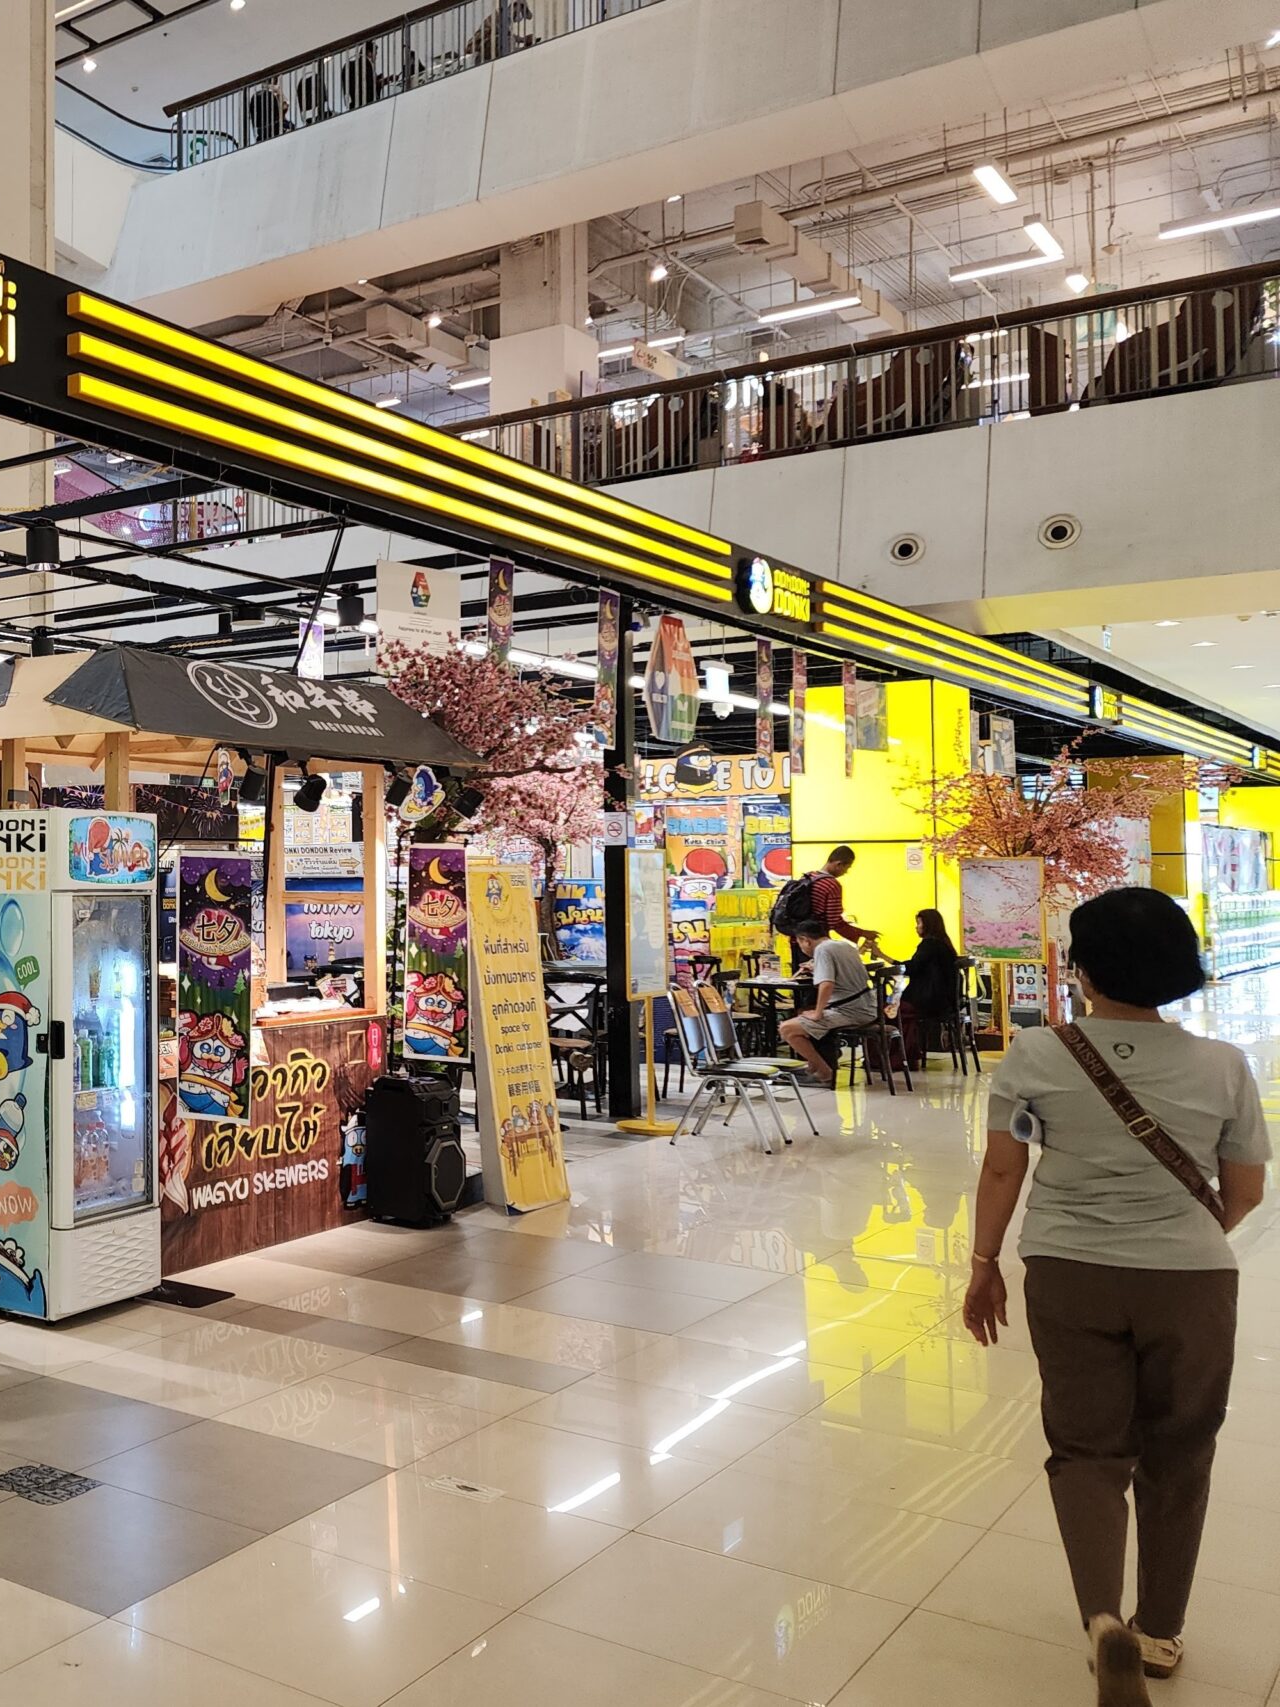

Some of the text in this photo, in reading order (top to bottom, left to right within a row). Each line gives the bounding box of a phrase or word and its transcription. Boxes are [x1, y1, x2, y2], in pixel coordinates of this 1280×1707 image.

[774, 588, 810, 622] DONKI
[423, 895, 455, 917] 七夕
[196, 914, 238, 944] 七夕
[309, 920, 355, 944] tokyo
[17, 961, 38, 980] COOL
[501, 1025, 521, 1036] space
[253, 1158, 329, 1196] SKEWERS
[192, 1177, 250, 1210] WAGYU
